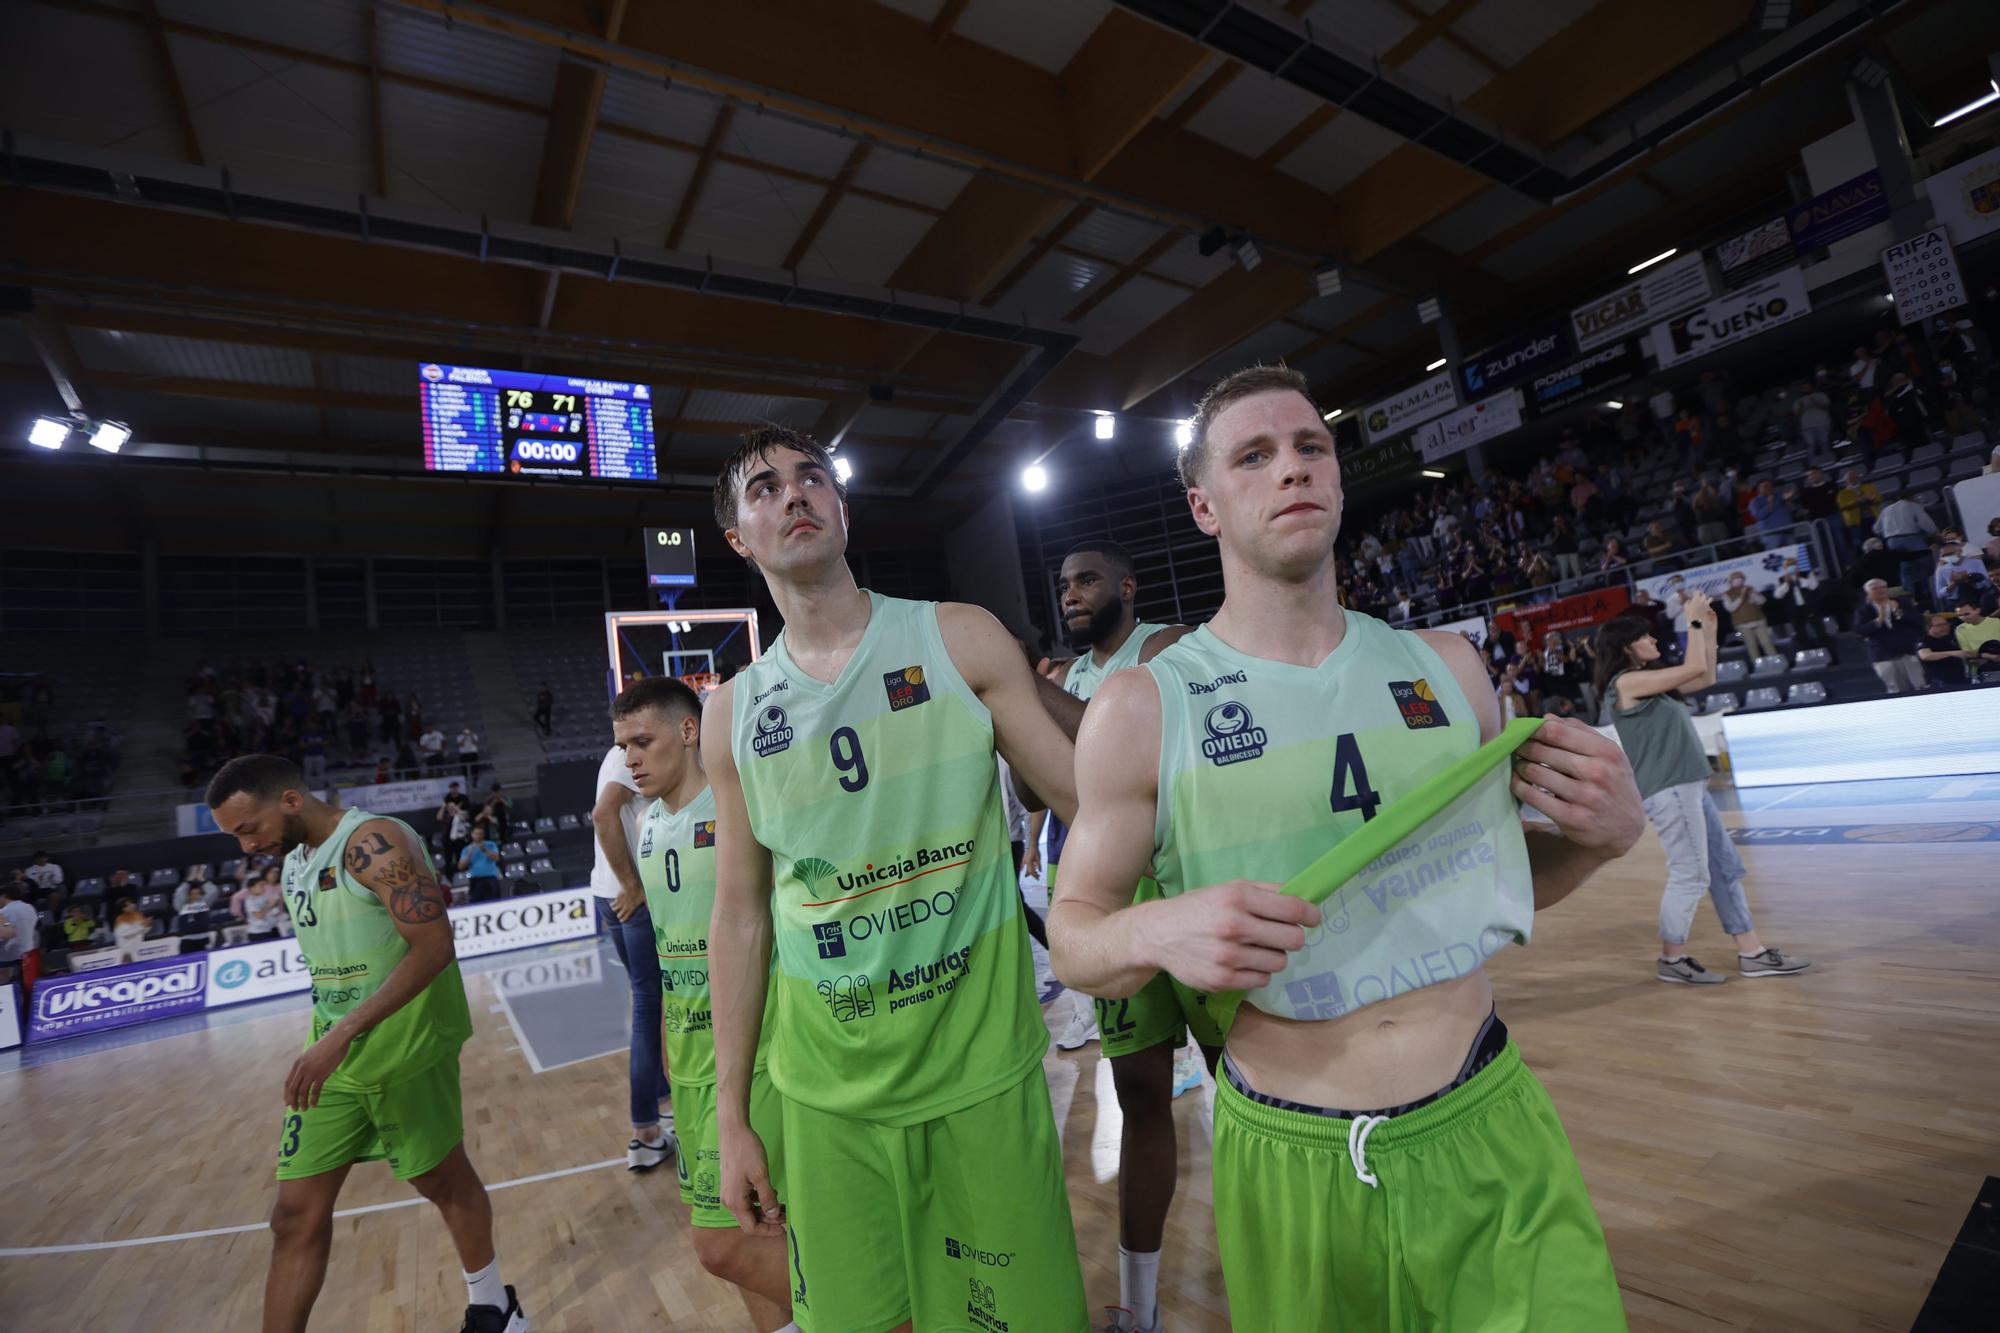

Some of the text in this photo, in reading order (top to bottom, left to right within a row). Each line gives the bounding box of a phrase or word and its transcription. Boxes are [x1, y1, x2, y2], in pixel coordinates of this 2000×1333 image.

[1886, 232, 1943, 262] RIFA
[1576, 292, 1644, 336] VICAR
[1684, 298, 1788, 351] SUEÑO
[1485, 334, 1558, 378] zunder
[507, 390, 533, 409] 76
[552, 394, 576, 413] 71
[518, 441, 576, 462] 00:00
[657, 531, 682, 546] 0.0
[754, 679, 789, 706] SPALDING
[887, 677, 902, 686] Liga
[890, 685, 912, 700] LEB
[1188, 670, 1248, 695] SPALDING
[1393, 688, 1414, 698] Liga
[892, 696, 914, 708] ORO
[1401, 702, 1430, 717] LEB
[1407, 715, 1433, 726] ORO
[754, 728, 792, 751] OVIEDO
[1203, 729, 1265, 757] OVIEDO
[829, 727, 870, 793] 9
[1217, 748, 1261, 765] BALONCESTO
[1330, 733, 1381, 823] 4
[665, 848, 681, 893] 0
[836, 839, 975, 891] Unicaja Banco
[294, 890, 318, 927] 23
[848, 890, 956, 940] OVIEDO
[666, 939, 697, 954] Unicaja
[49, 963, 199, 1015] vicapal
[1095, 998, 1137, 1036] 22
[961, 1243, 1010, 1268] OVIEDO
[967, 1300, 1008, 1333] Asturias
